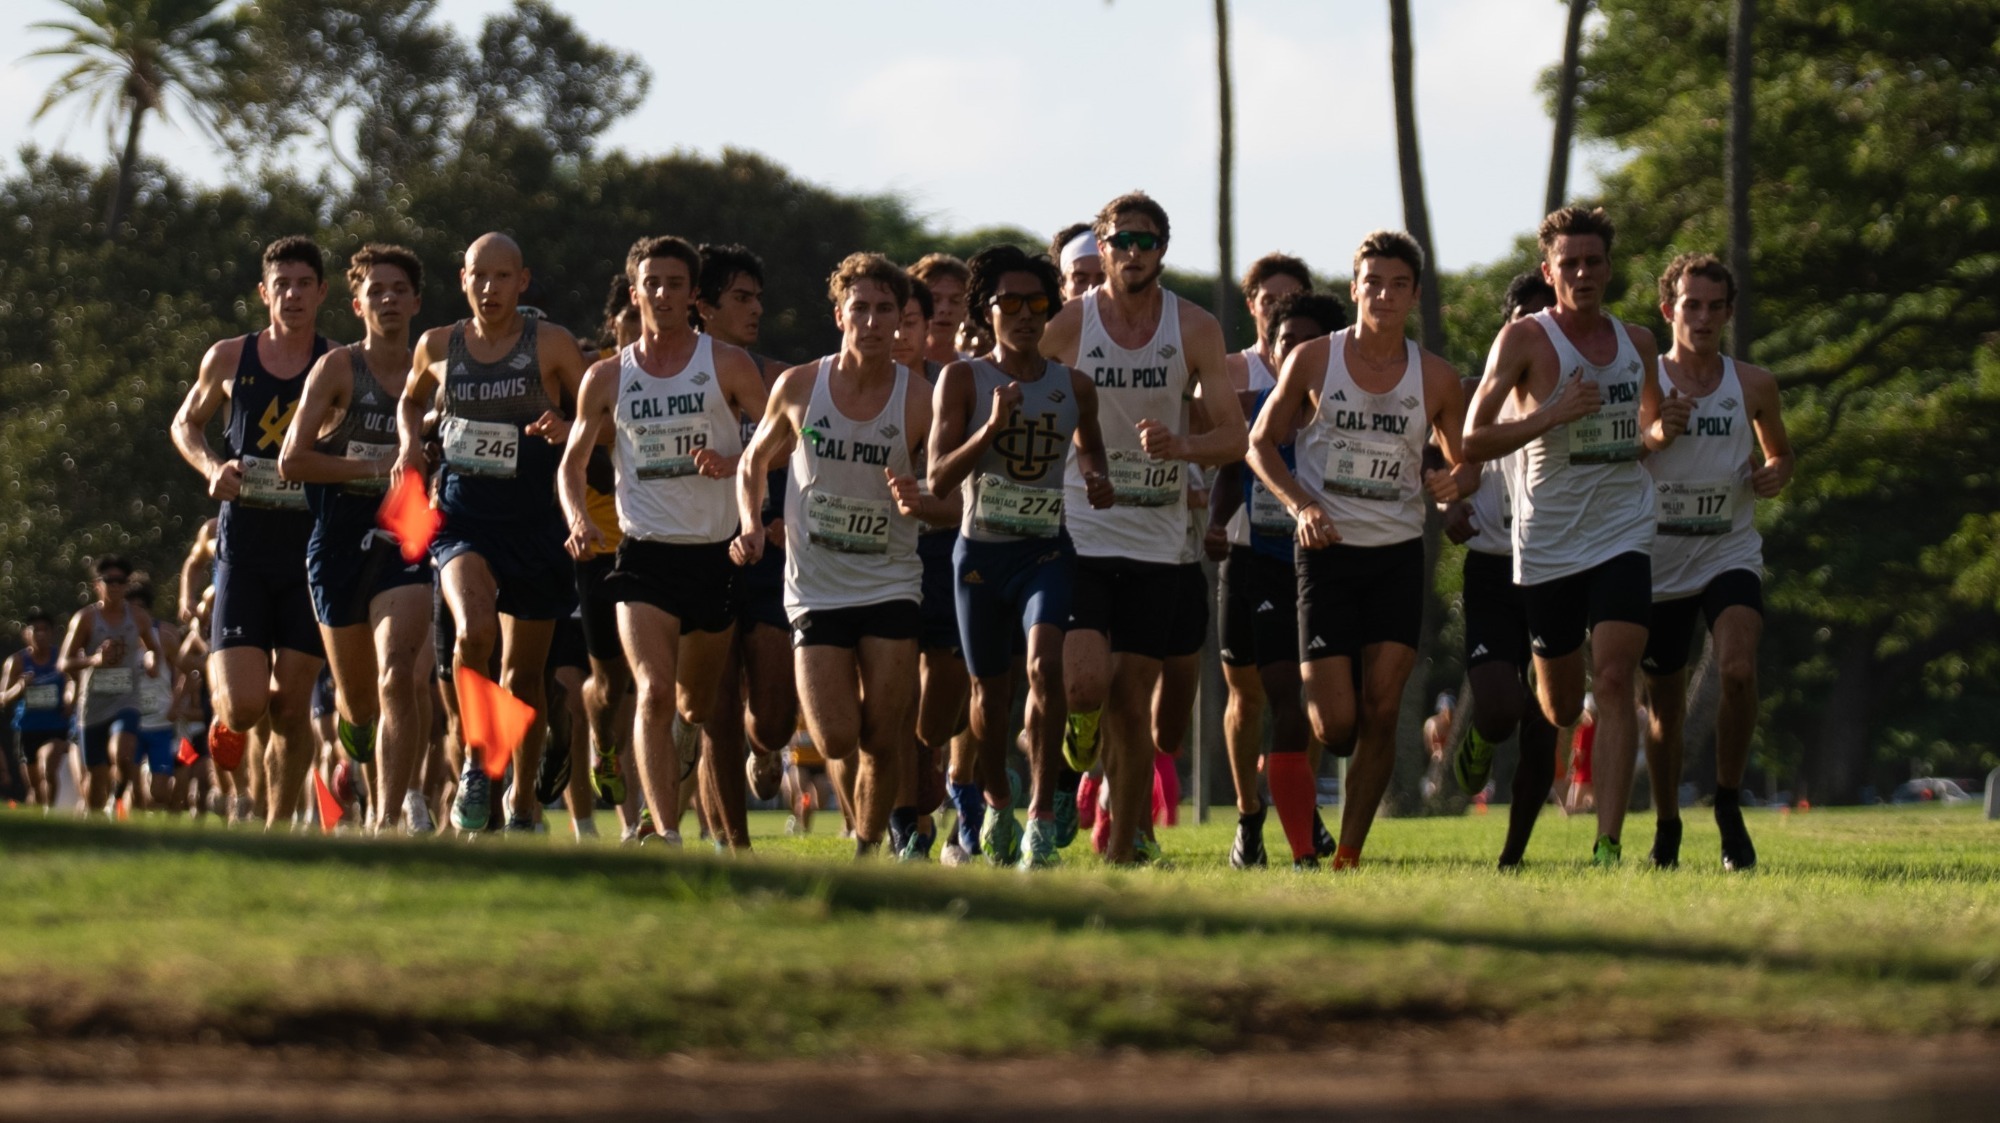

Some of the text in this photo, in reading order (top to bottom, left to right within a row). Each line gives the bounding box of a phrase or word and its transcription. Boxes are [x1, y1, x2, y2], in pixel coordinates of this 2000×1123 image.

[1095, 366, 1168, 388] CAL POLY
[457, 377, 526, 401] UC DAVIS
[631, 392, 705, 420] CAL POLY
[1336, 410, 1409, 435] CAL POLY
[1612, 418, 1637, 440] 110
[1697, 416, 1733, 436] POLY
[474, 438, 517, 459] 246
[675, 432, 708, 456] 119
[816, 437, 892, 466] CAL POLY
[1144, 465, 1179, 487] 104
[1370, 459, 1401, 480] 114
[1019, 497, 1062, 516] 274
[1697, 494, 1727, 515] 117
[848, 513, 888, 536] 102
